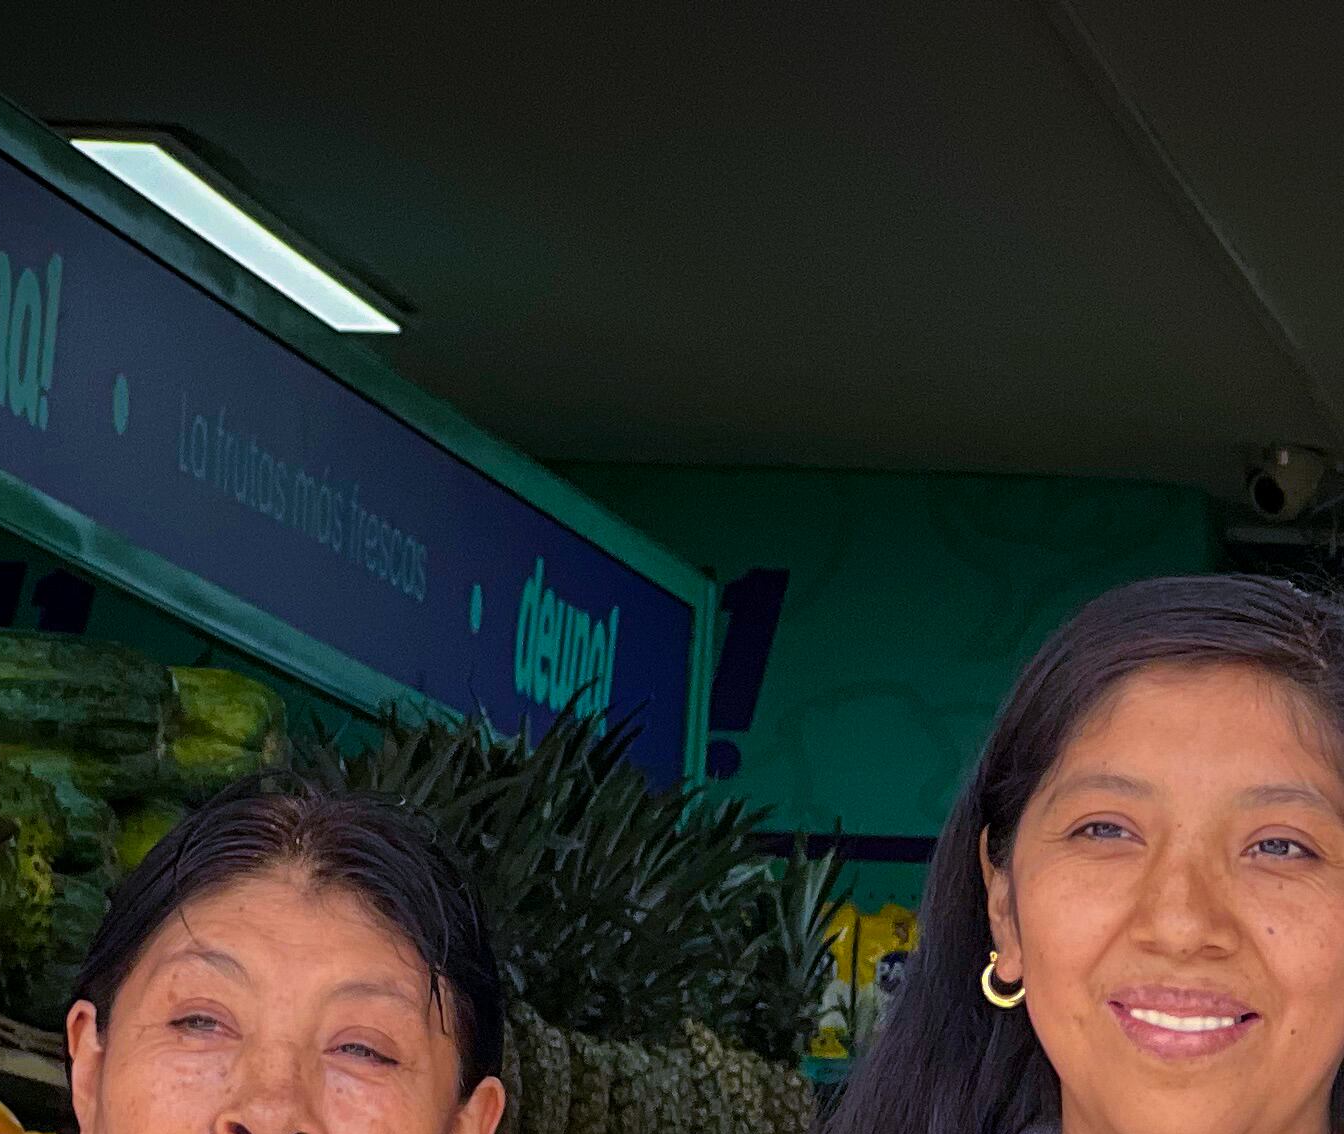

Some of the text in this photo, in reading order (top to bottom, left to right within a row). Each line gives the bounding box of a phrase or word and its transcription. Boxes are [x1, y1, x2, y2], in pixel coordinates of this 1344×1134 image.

[176, 390, 429, 603] La frutas más frescas
[512, 553, 621, 738] deuna!
